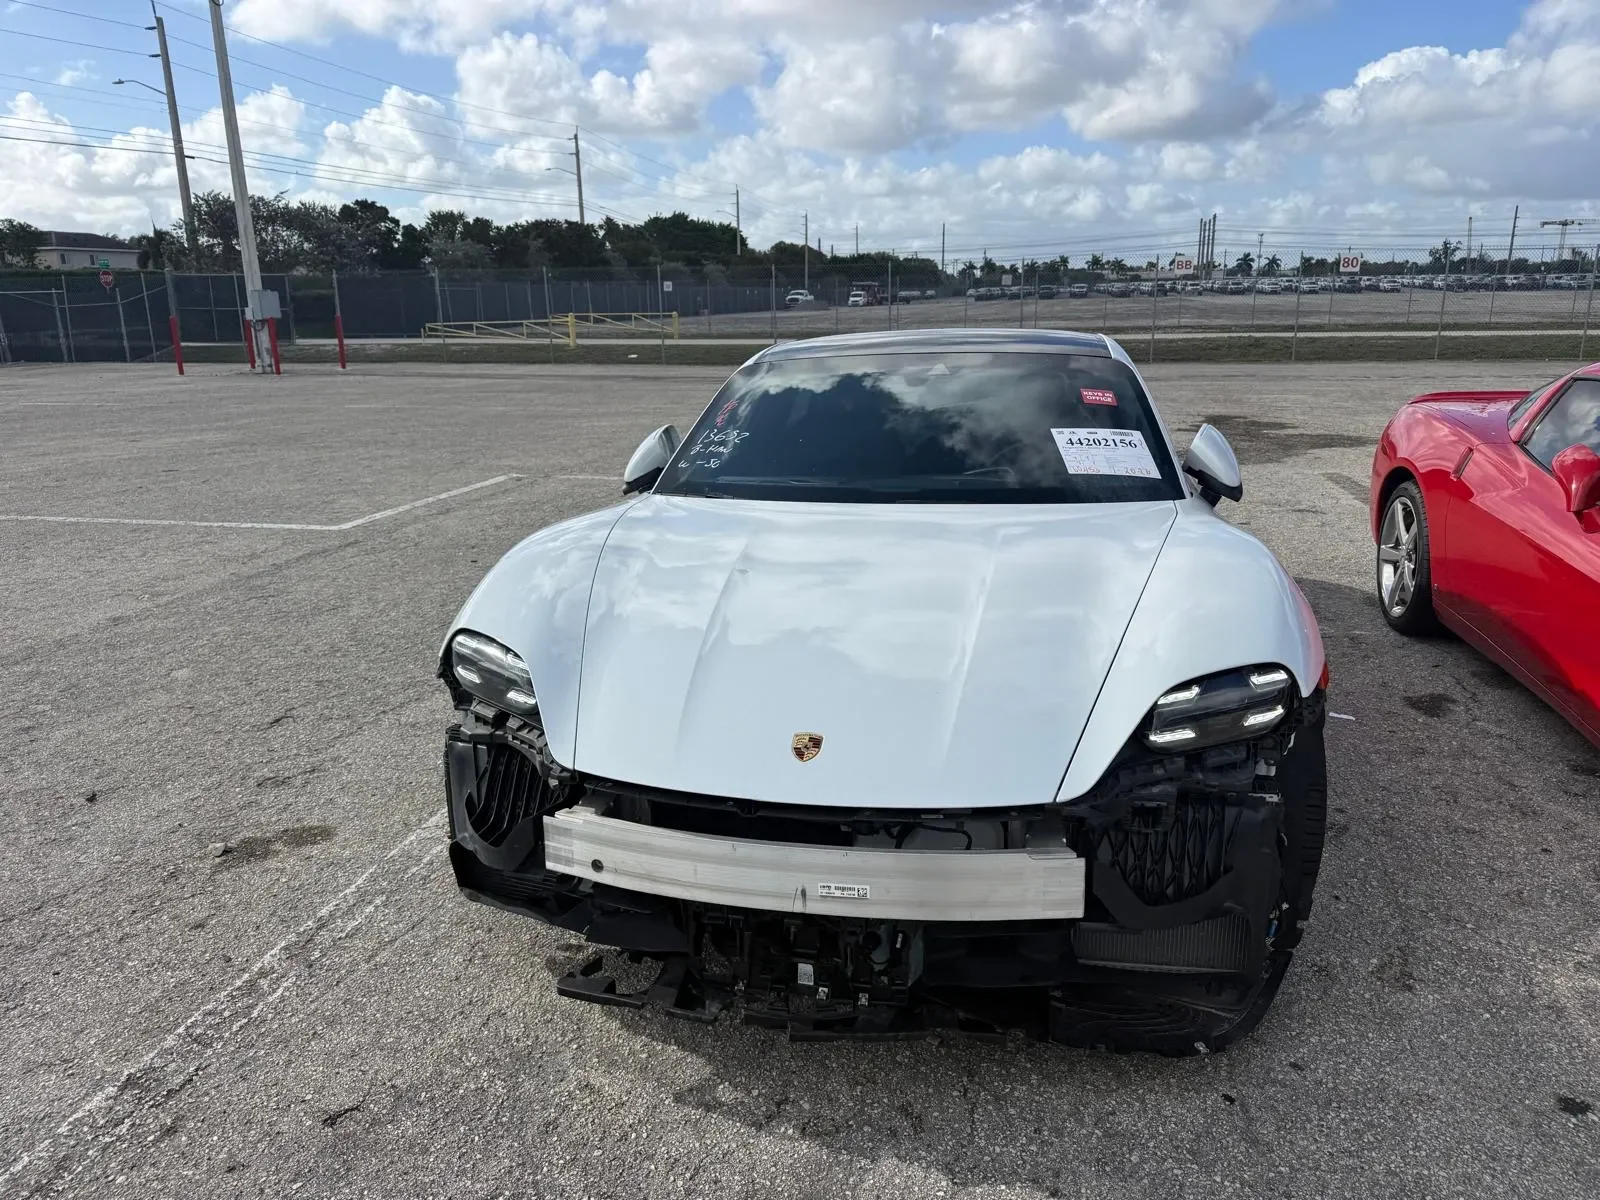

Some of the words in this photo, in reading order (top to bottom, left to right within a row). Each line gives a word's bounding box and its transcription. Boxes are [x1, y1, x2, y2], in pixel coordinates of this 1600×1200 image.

[1176, 260, 1193, 270] BB
[1341, 257, 1359, 268] 80
[1086, 395, 1113, 403] OFFICE
[1066, 437, 1137, 449] 44202156
